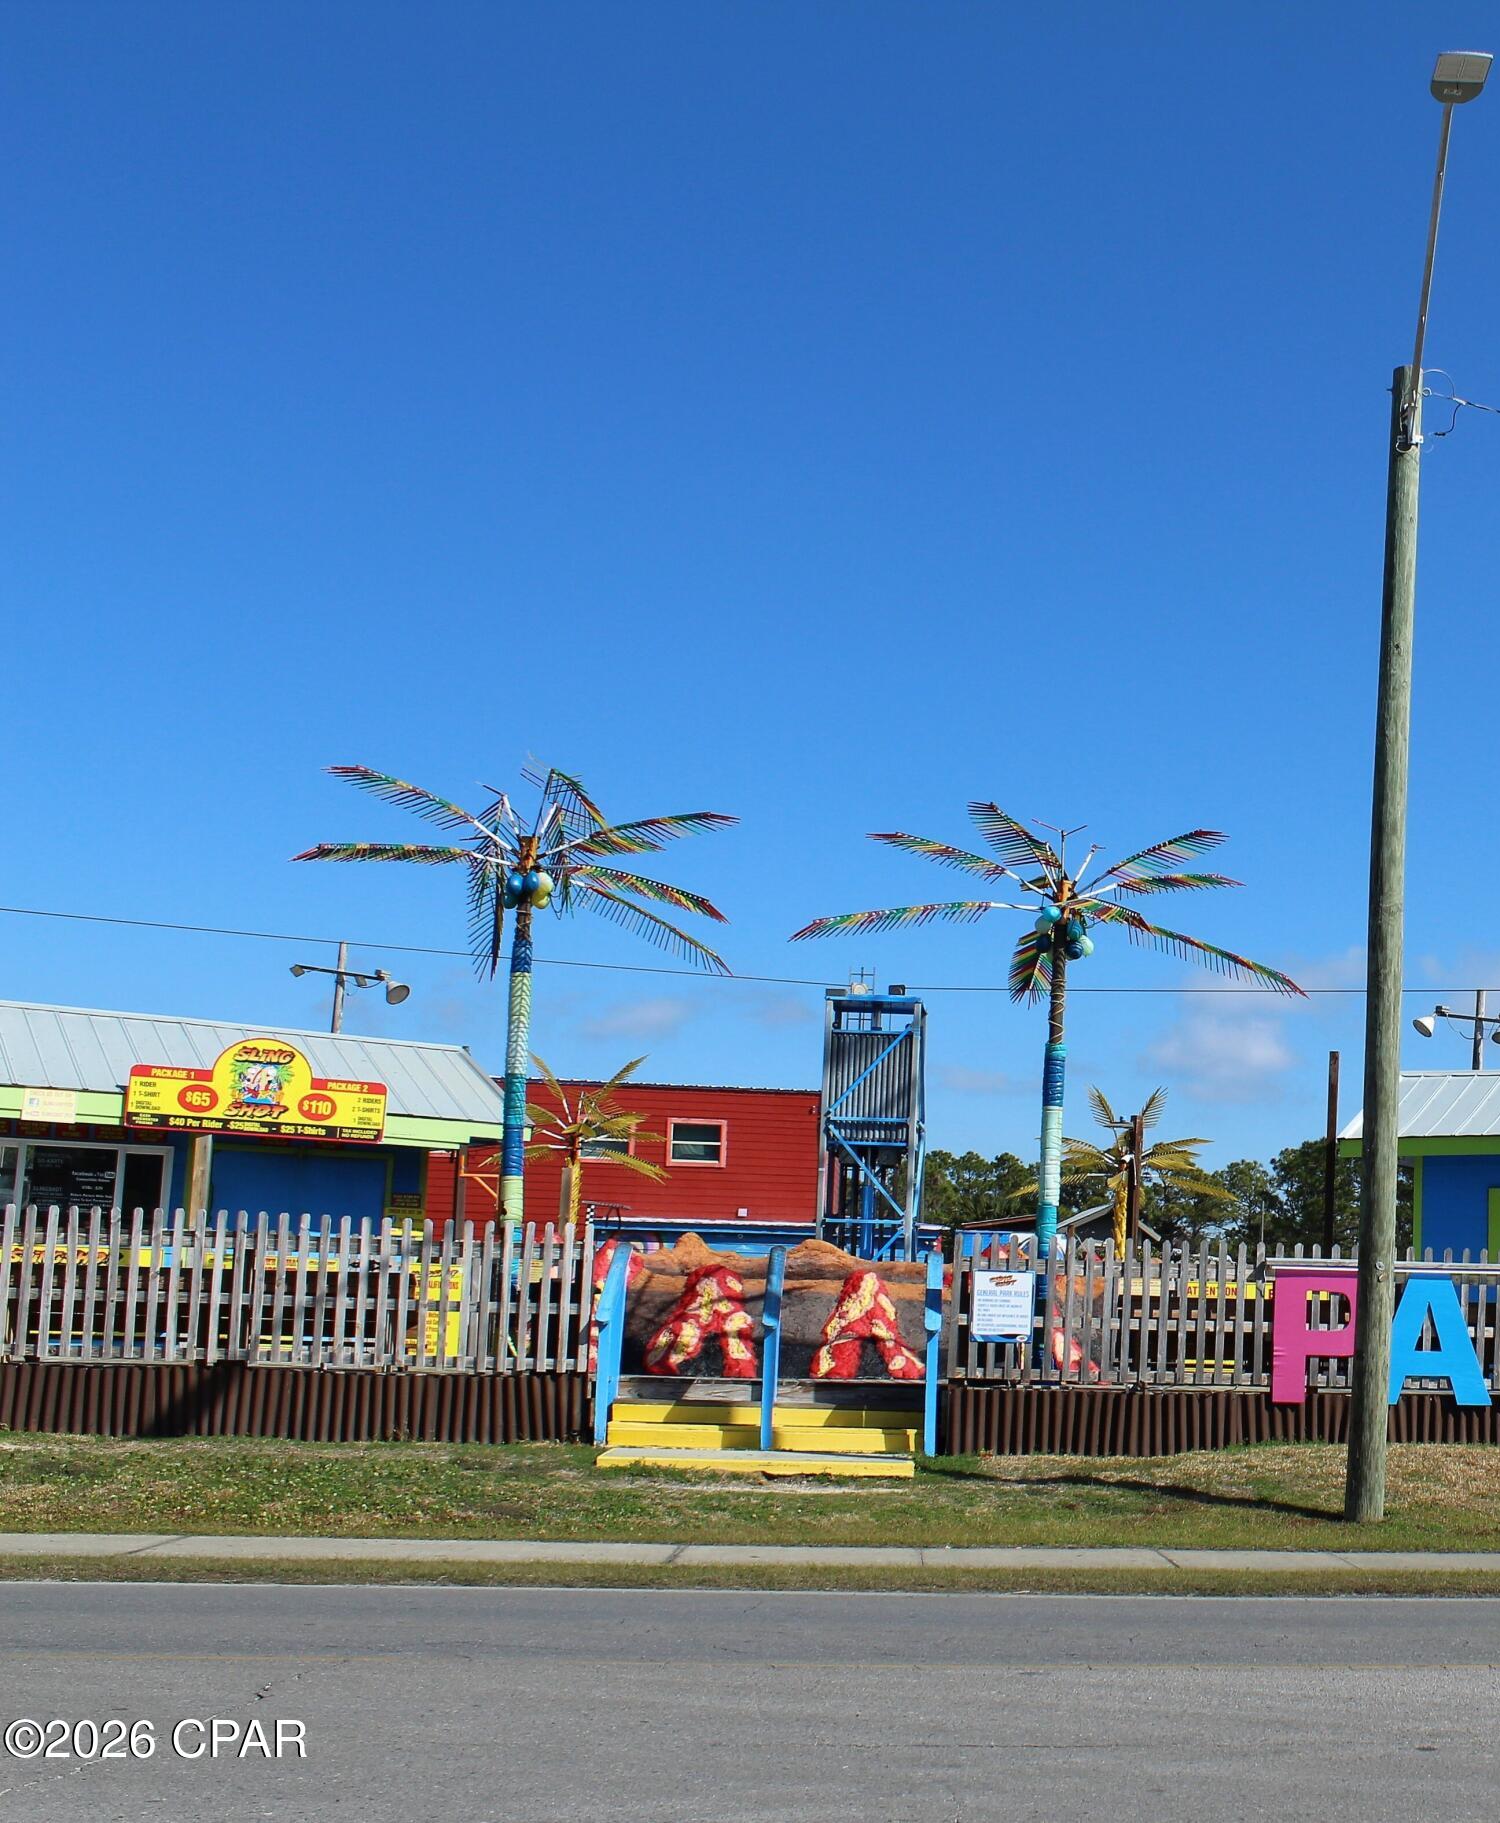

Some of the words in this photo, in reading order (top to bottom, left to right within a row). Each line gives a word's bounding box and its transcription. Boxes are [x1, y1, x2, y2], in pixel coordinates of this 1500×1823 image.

[151, 1068, 188, 1078] PACKAGE
[327, 1082, 361, 1092] PACKAGE
[185, 1091, 211, 1107] $65
[223, 1102, 289, 1119] SHOT
[302, 1099, 332, 1115] $110
[169, 1117, 185, 1126] $40
[187, 1119, 201, 1127] Per
[202, 1119, 223, 1128] Rider
[280, 1125, 295, 1134] $25
[297, 1126, 326, 1135] T-Shirts
[1187, 1286, 1238, 1297] ATENON
